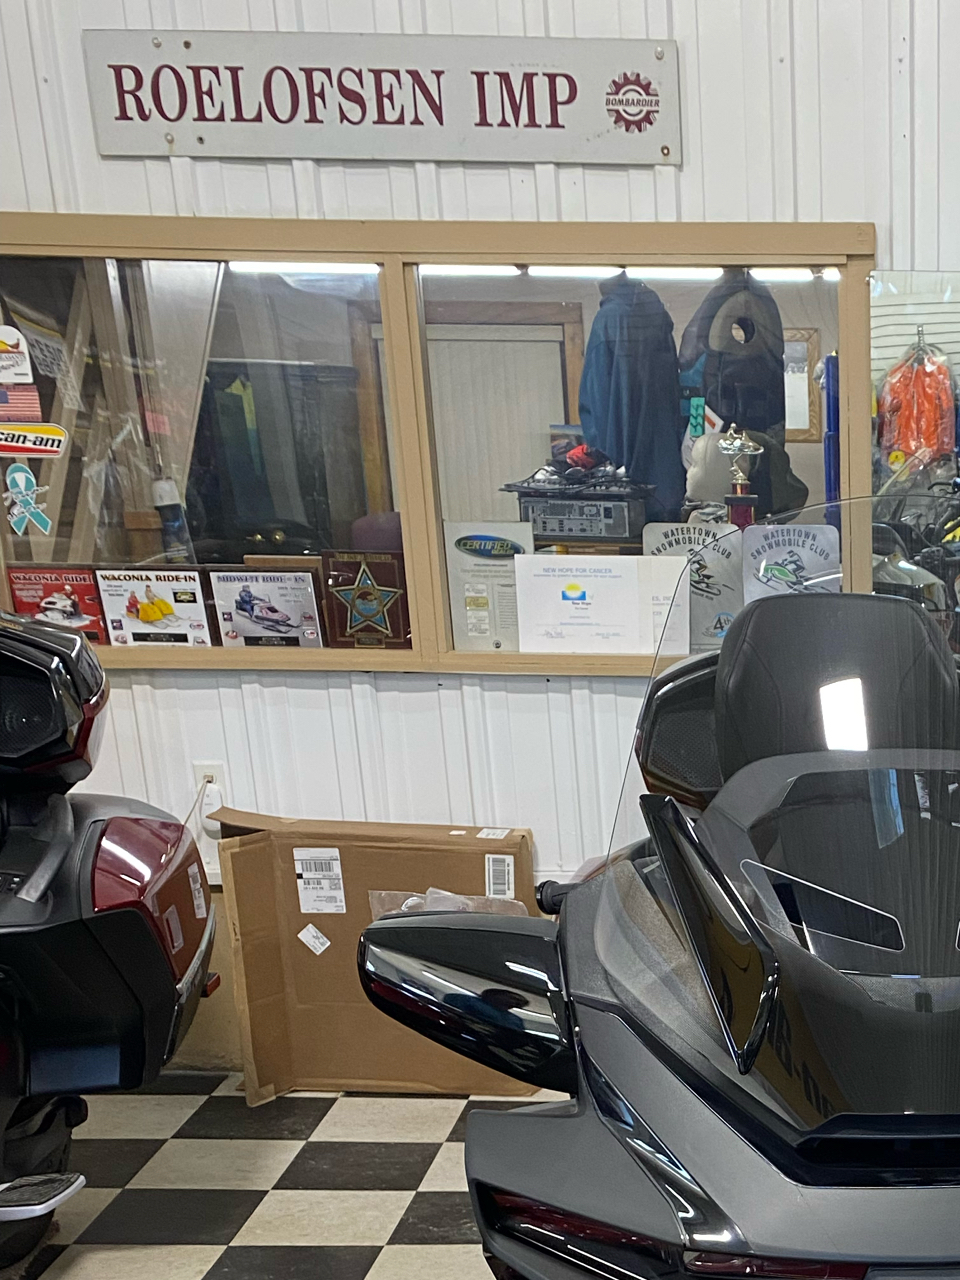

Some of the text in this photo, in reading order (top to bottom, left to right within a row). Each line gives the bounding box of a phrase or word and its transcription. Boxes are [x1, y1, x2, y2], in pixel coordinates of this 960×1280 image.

[107, 63, 578, 129] ROELOFSEN IMP
[605, 96, 660, 109] BOMBARDIER
[662, 526, 719, 543] WATERTOWN
[762, 528, 818, 542] WATERTOWN
[460, 540, 512, 550] CERTIFIED
[650, 536, 732, 559] SNOWMOBILE CLUB
[750, 537, 830, 560] SNOWMOBILE CLUB
[11, 573, 61, 583] WACONIA
[100, 574, 197, 583] WACONIA RIDE-IN
